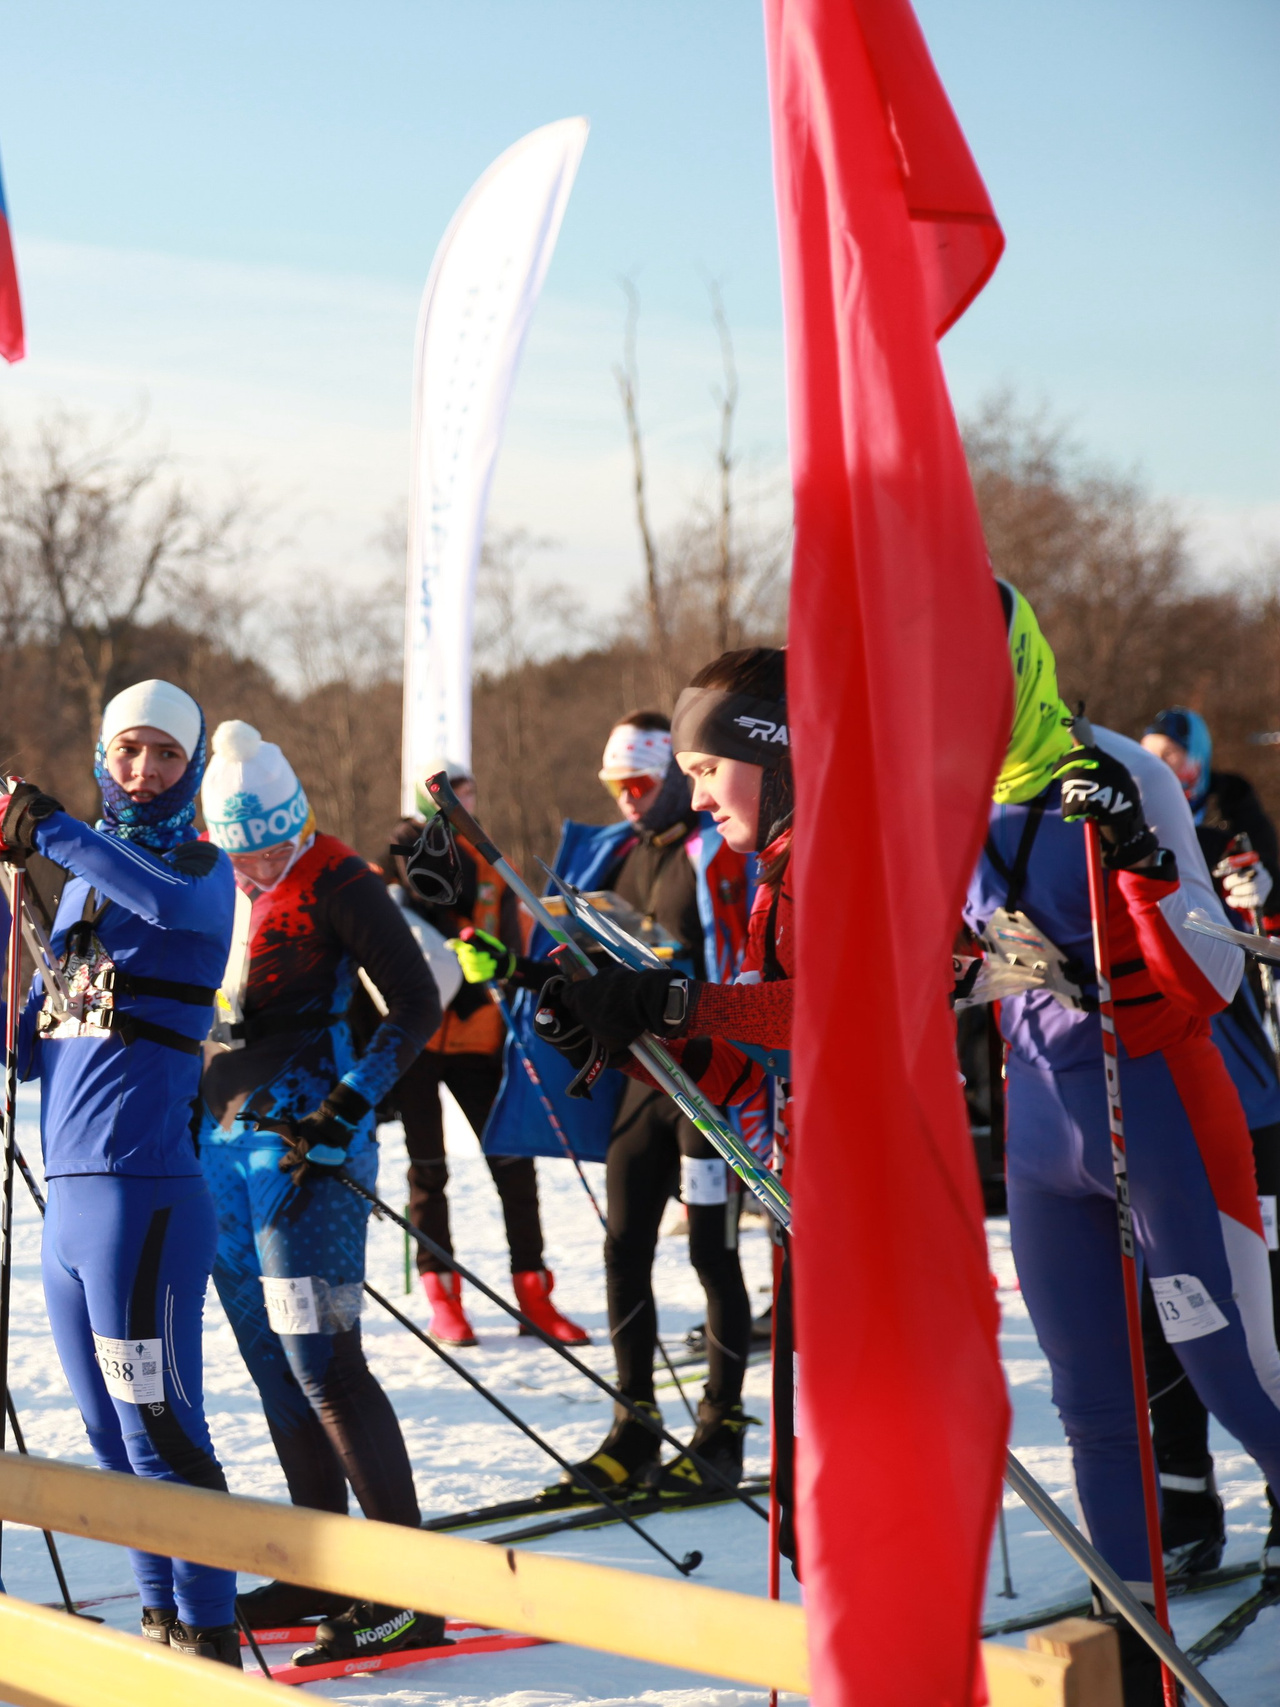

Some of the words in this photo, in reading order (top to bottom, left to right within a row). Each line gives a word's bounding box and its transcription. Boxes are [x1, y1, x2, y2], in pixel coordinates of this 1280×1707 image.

[733, 715, 789, 746] RA
[1061, 779, 1133, 814] RAY
[246, 790, 308, 845] РОСС
[102, 1357, 135, 1382] 238
[354, 1609, 416, 1648] NORDWAY
